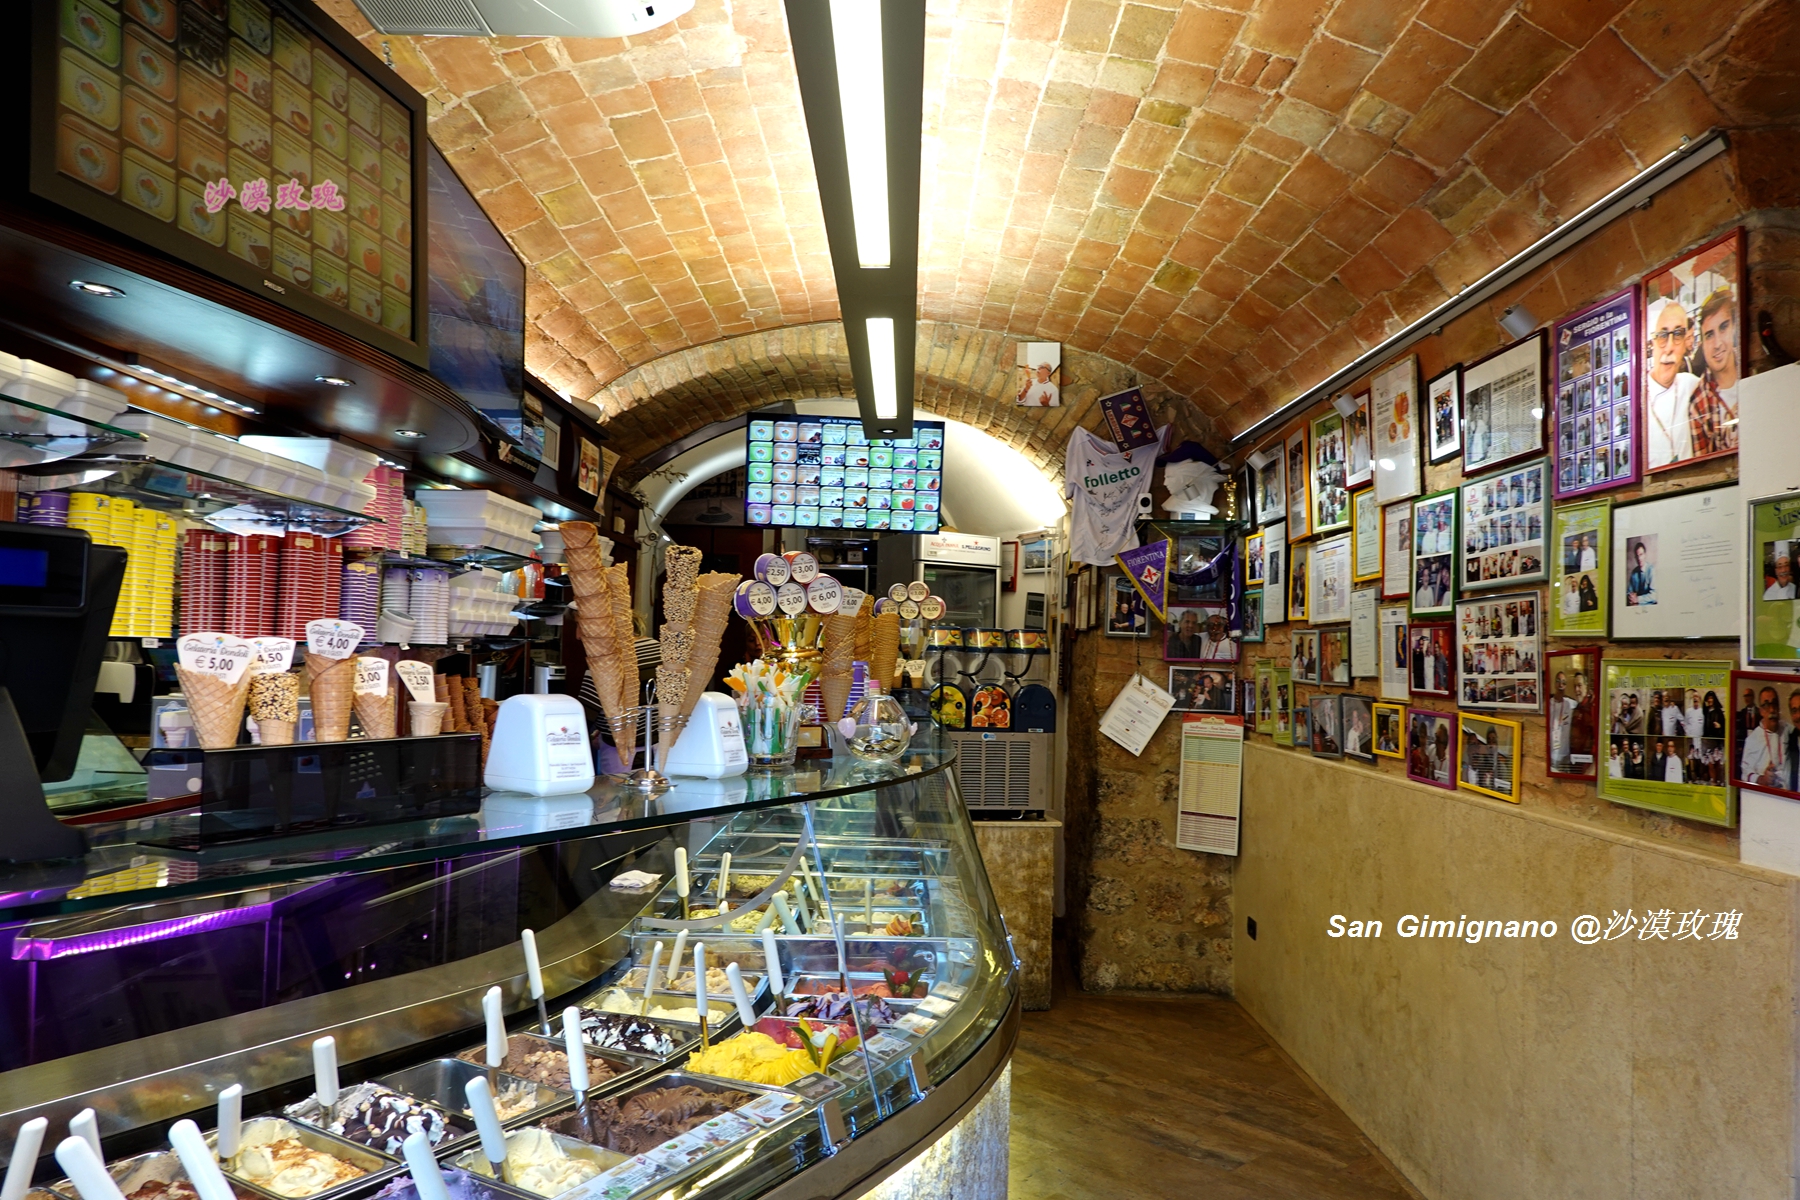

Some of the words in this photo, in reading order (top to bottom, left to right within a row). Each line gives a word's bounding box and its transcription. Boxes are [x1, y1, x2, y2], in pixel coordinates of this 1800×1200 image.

[1573, 316, 1599, 334] SERGIO
[1584, 312, 1628, 337] FIORENTINA
[1084, 466, 1140, 489] folletto
[1127, 550, 1165, 568] FIORENTINA
[757, 596, 772, 605] 4,00
[787, 596, 803, 606] 5,00
[818, 591, 837, 602] 6,00
[327, 637, 349, 650] 4,00
[220, 646, 249, 658] Dondoli
[257, 652, 283, 664] 4,50
[208, 657, 234, 671] 5,00
[358, 671, 381, 684] 3,00
